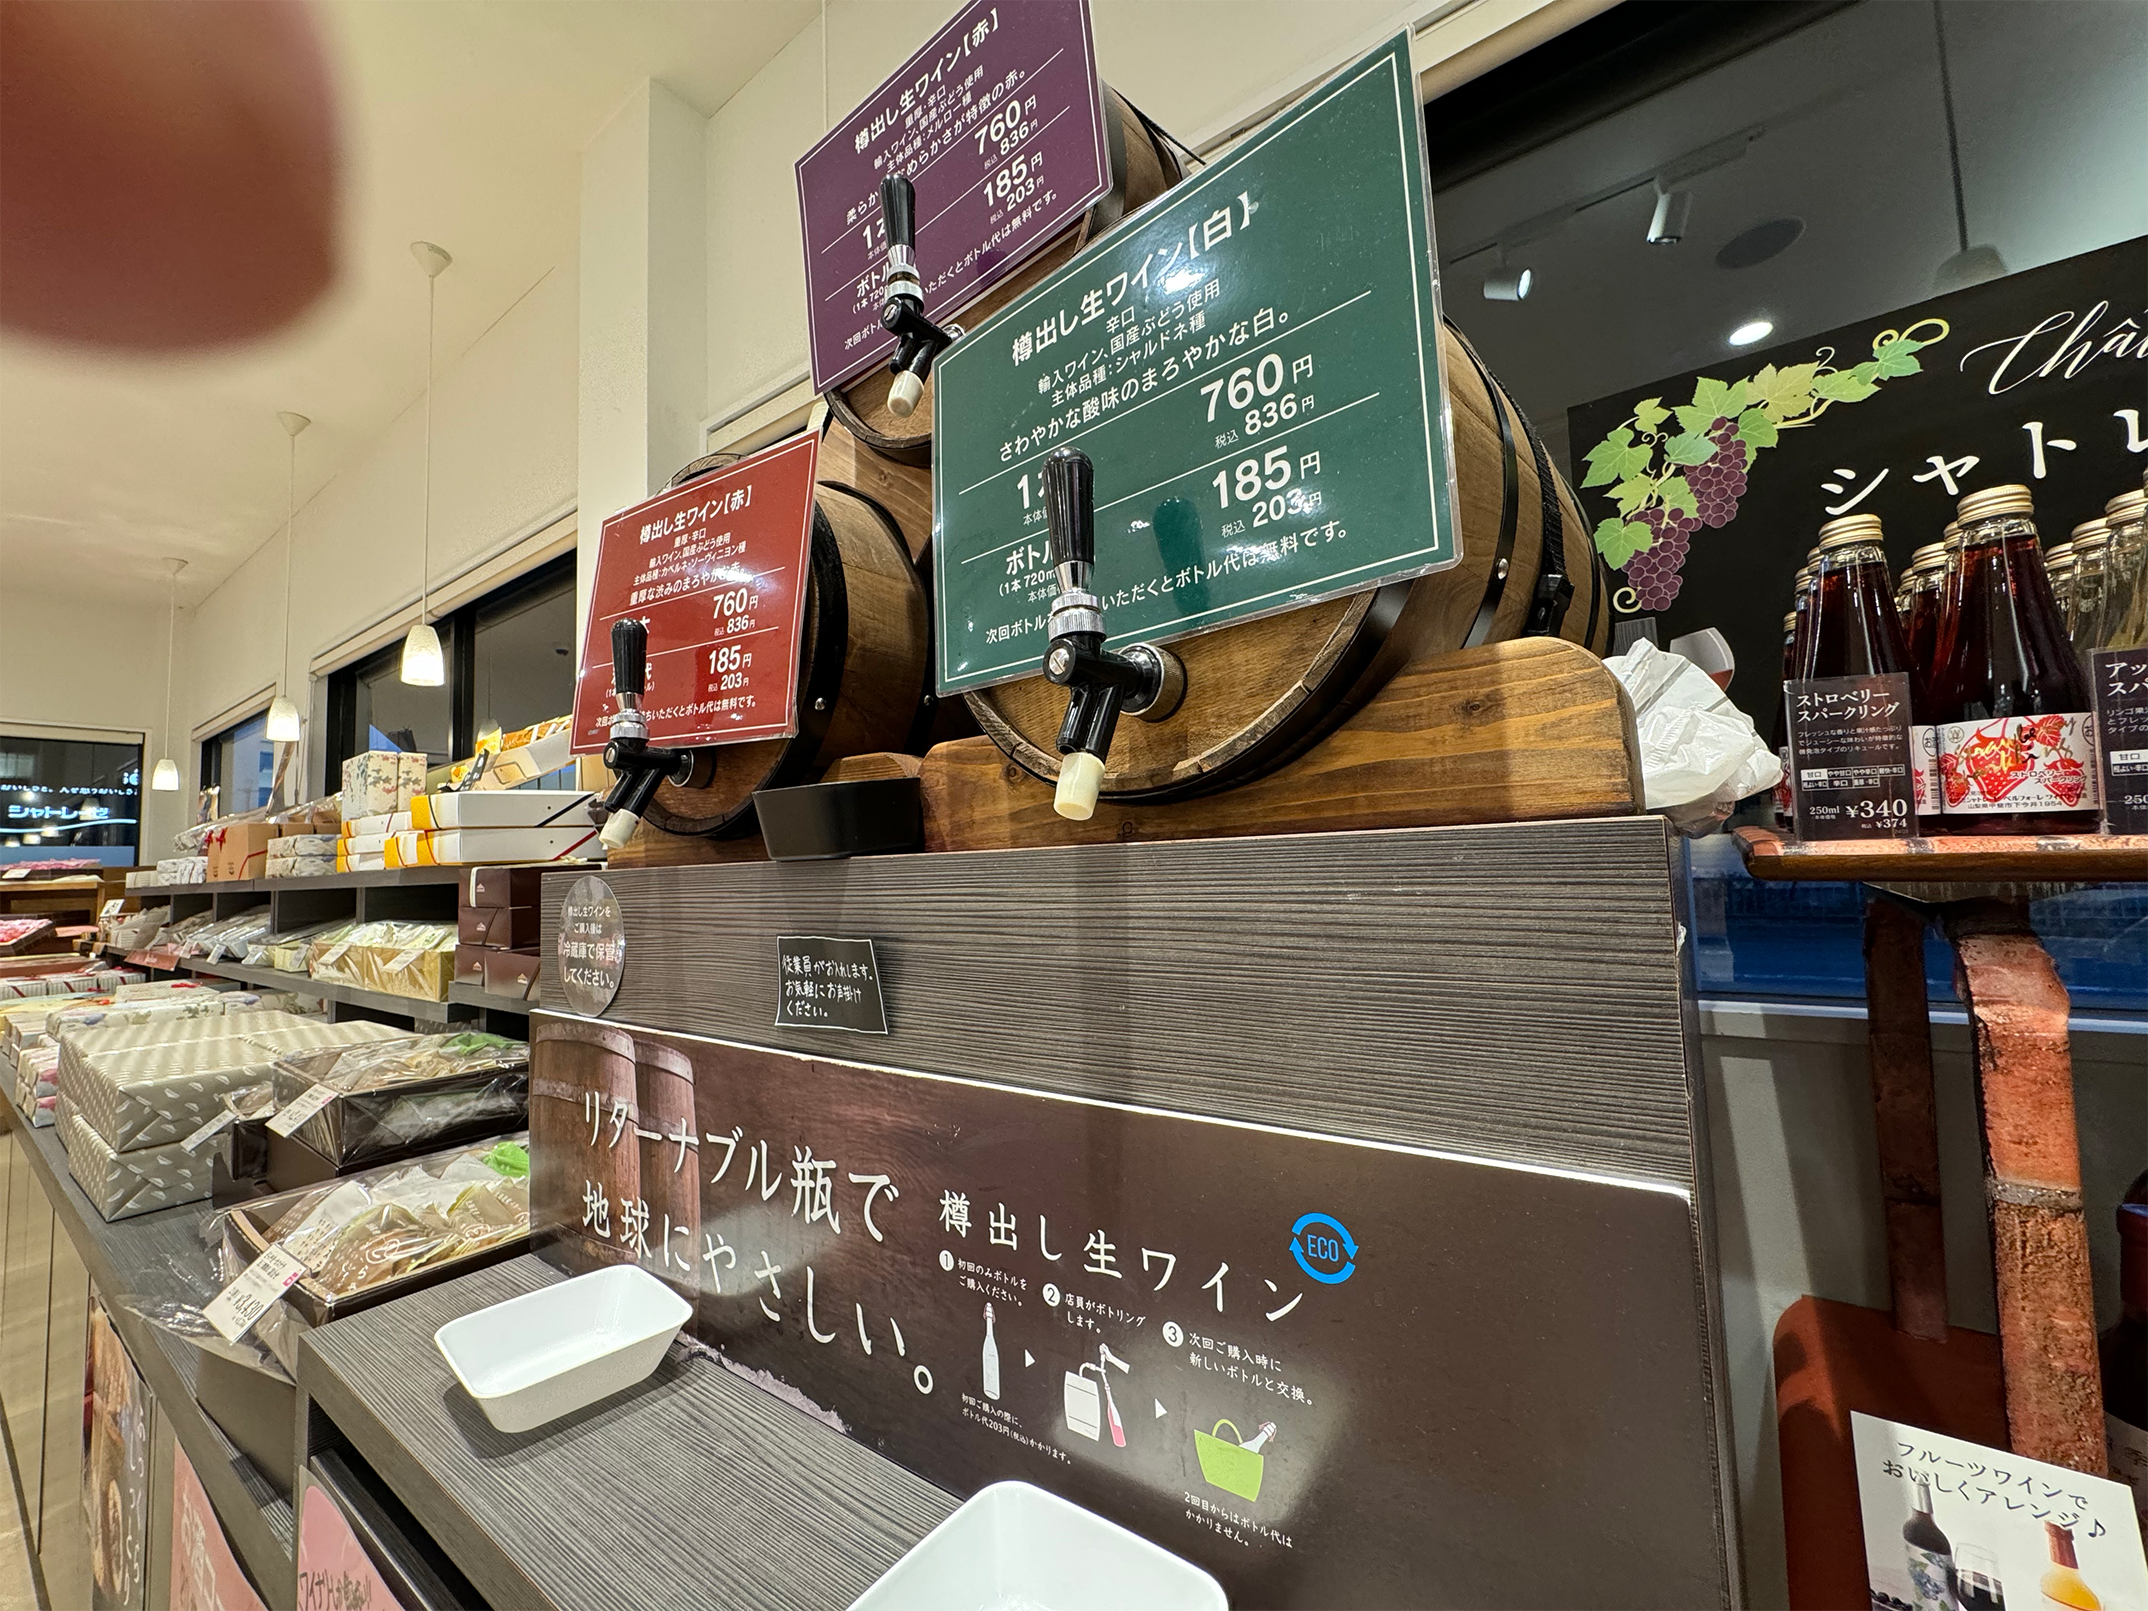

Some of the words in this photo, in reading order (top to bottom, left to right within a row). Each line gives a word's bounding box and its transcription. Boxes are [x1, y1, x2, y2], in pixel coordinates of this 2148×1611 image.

[854, 7, 999, 154] 樽出し生ワイン【赤】
[1011, 191, 1251, 367] 樽出し生ワイン【白】
[1105, 305, 1136, 333] 辛口
[1038, 278, 1220, 395] 輸入ワイン、国産ぶどう使用
[1960, 300, 2148, 395] Châ
[999, 307, 1289, 462] さわやかな酸味のまろやかな白。
[1214, 428, 1239, 449] 税込
[1017, 471, 1045, 510] 1
[639, 484, 752, 545] 樽出し生ワイン【赤】
[1221, 519, 1245, 538] 税込
[1796, 688, 1890, 708] ストロベリー
[1797, 701, 1900, 723] スパークリング
[2119, 752, 2140, 761] 甘口
[2010, 770, 2063, 779] ストロベリー
[2034, 774, 2087, 785] スパークリング
[8, 804, 109, 819] シャトレーゼ
[1809, 805, 1840, 815] 250ml
[1875, 818, 1908, 829] ¥374
[563, 965, 614, 988] してください。
[781, 954, 873, 981] 従業員がお入れします。
[785, 979, 861, 1003] お気軽にお声掛け
[786, 1000, 828, 1017] ください。
[585, 1090, 900, 1242] リターナブル瓶で
[939, 1189, 1303, 1322] 樽出し生ワイン
[1306, 1233, 1340, 1262] ECO
[582, 1179, 934, 1395] 地球にやさしい。
[957, 1257, 1027, 1290] 初回のみボトルを
[958, 1275, 1023, 1307] ご購入ください。
[1064, 1293, 1147, 1327] 店員がボトリング
[1067, 1311, 1101, 1334] します。
[1189, 1332, 1282, 1372] 次回ご購入時に
[1189, 1351, 1313, 1406] 新しいボトルと交換。
[1897, 1441, 2089, 1510] フルーツワインで
[1184, 1491, 1293, 1549] 2回目からはボトル代は
[1185, 1508, 1249, 1547] かかりません。
